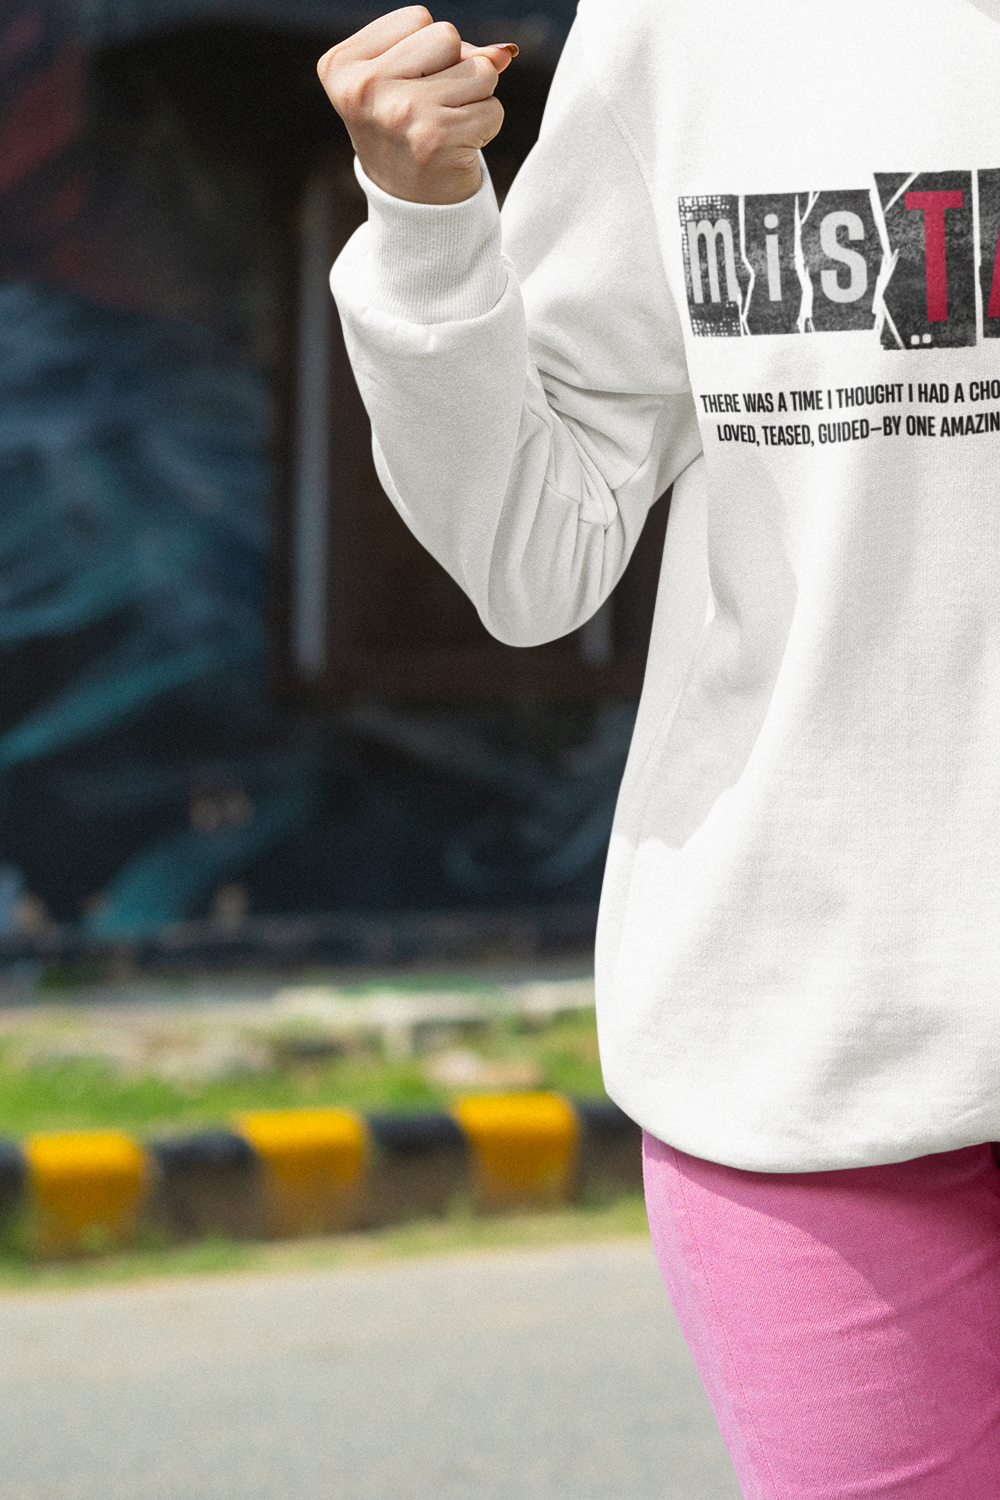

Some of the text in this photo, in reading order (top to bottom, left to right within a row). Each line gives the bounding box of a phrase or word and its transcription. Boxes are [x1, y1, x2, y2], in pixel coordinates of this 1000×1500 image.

[700, 393, 741, 413] THERE
[743, 392, 774, 413] WAS
[778, 391, 788, 412] A
[790, 390, 823, 412] TIME
[827, 389, 833, 410] I
[836, 383, 904, 408] THOUGHT
[908, 383, 914, 403] I
[918, 383, 949, 403] HAD
[954, 382, 965, 403] A
[717, 424, 760, 446] LOVED,
[761, 424, 815, 446] TEASED,
[906, 415, 936, 436] ONE
